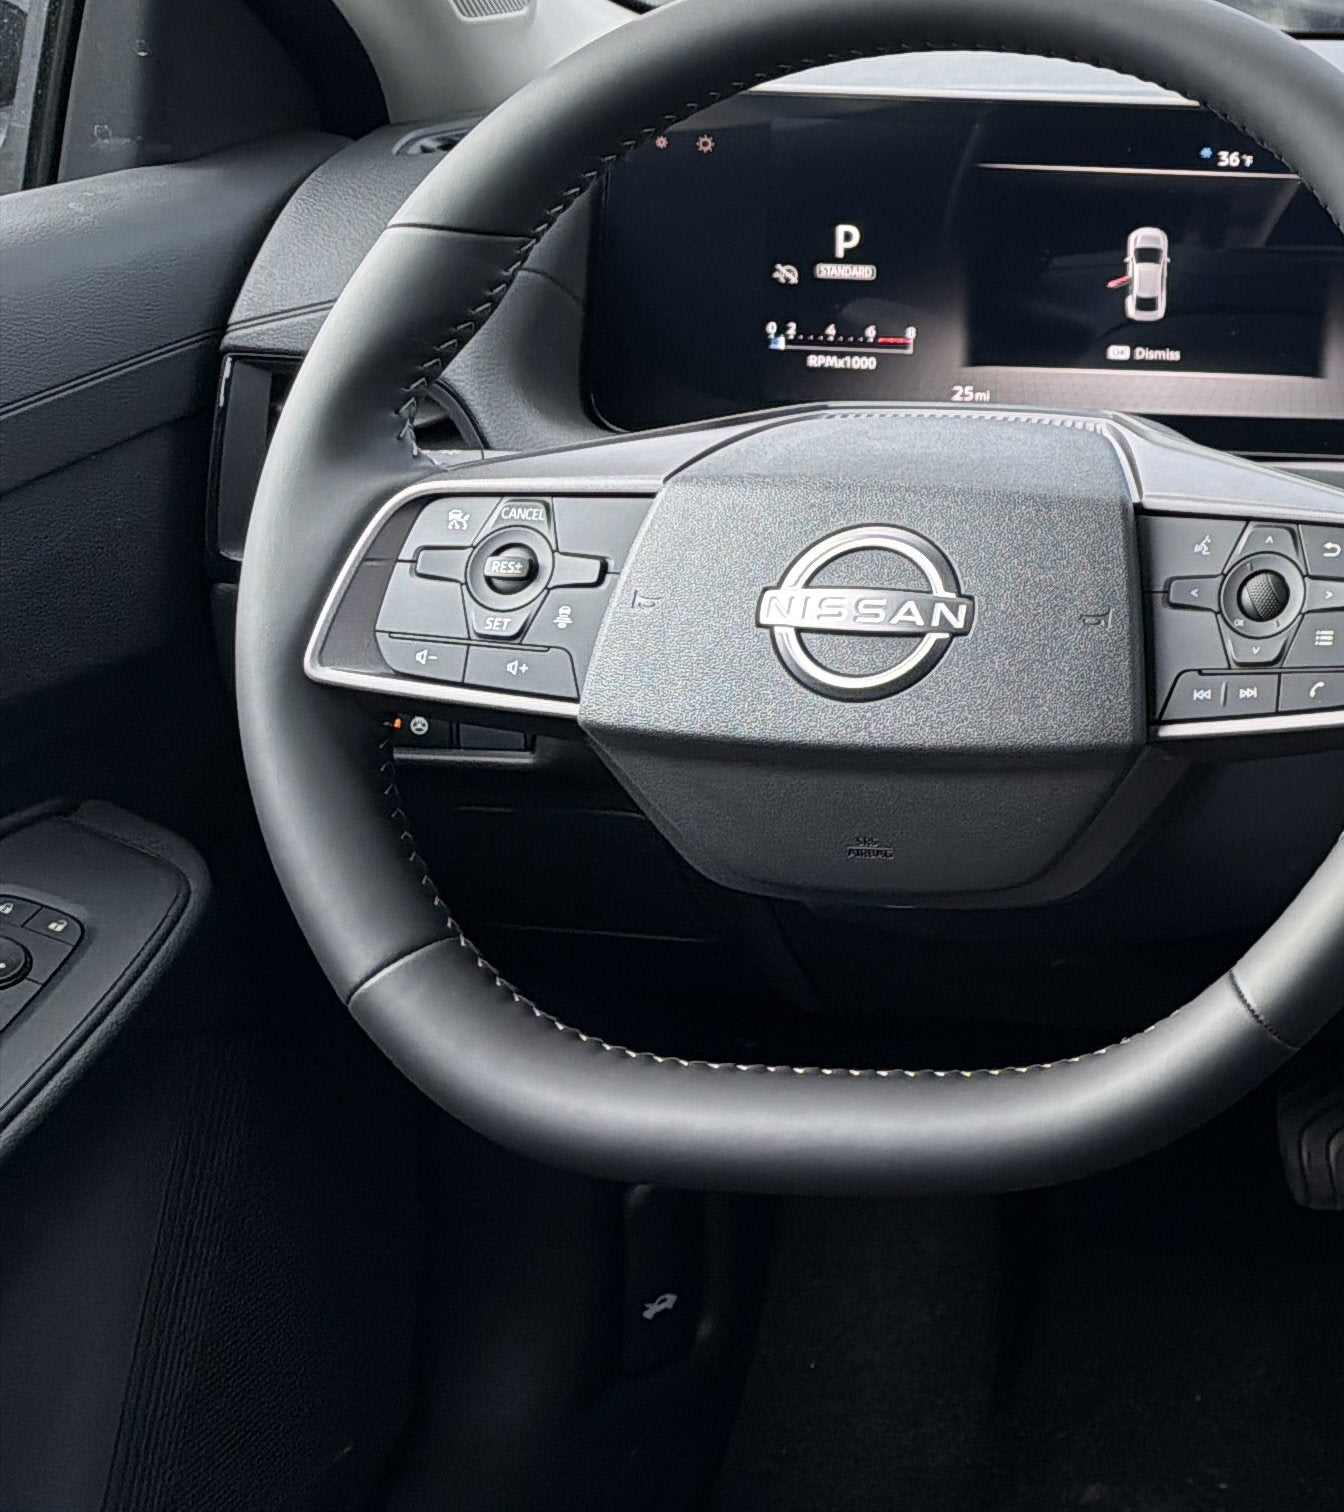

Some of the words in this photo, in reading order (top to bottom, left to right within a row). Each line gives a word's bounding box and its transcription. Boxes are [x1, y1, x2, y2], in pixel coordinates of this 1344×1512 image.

[835, 223, 861, 259] P
[817, 265, 874, 279] STANDARD
[785, 322, 797, 335] 2
[825, 323, 837, 336] 4
[864, 325, 876, 339] 6
[1134, 346, 1181, 362] Dismiss
[501, 506, 545, 522] CANCEL
[766, 595, 967, 630] NISSAN
[484, 616, 512, 631] SET
